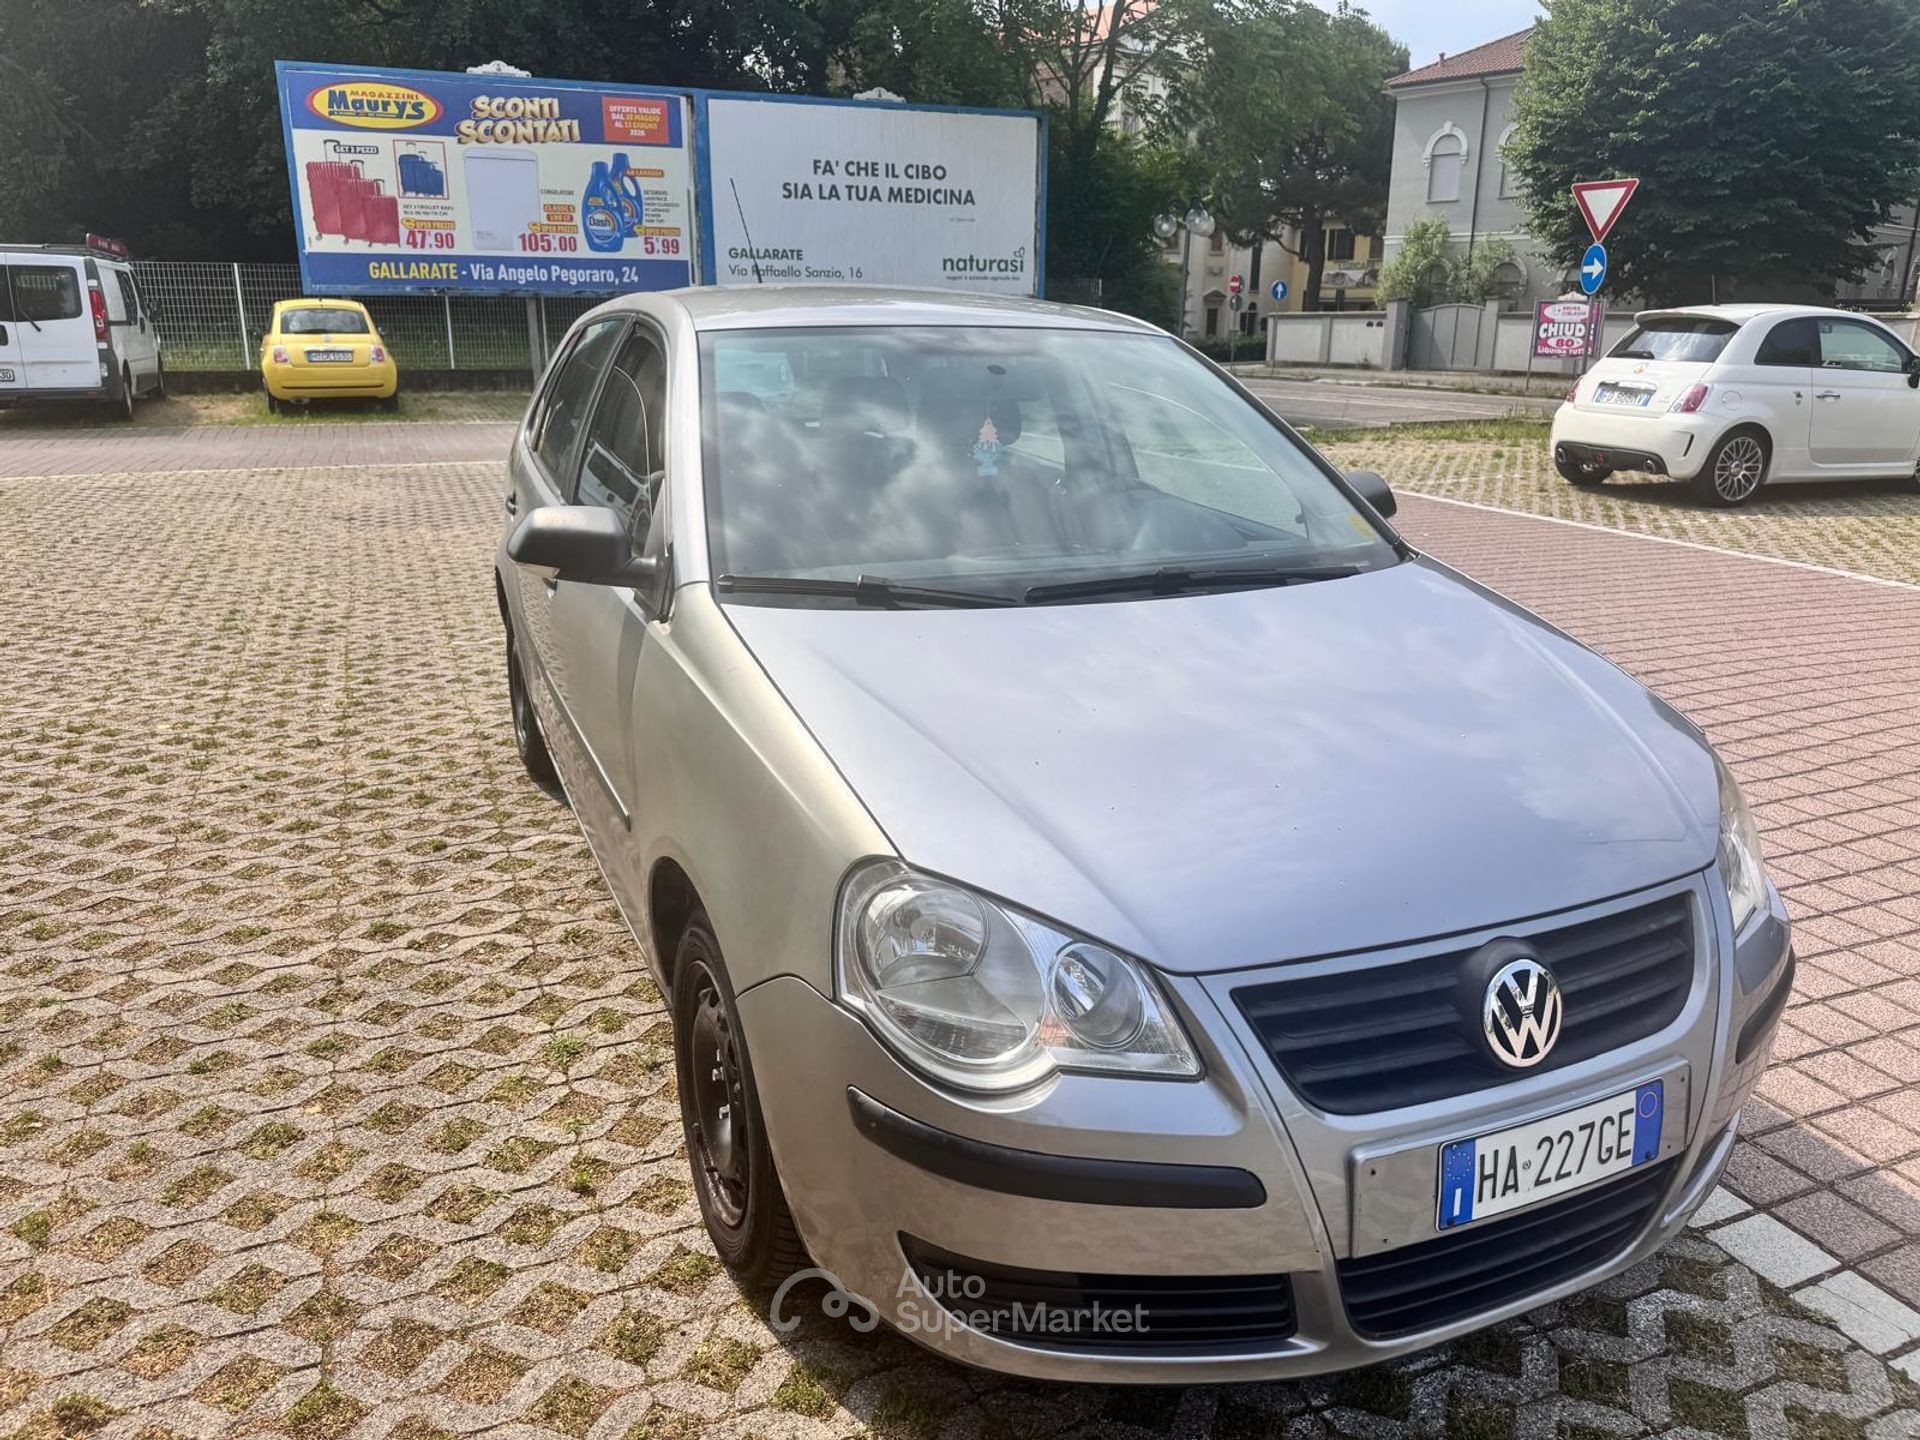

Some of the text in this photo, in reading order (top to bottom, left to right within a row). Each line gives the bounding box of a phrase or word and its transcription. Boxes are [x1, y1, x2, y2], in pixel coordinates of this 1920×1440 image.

[350, 90, 419, 100] MAGAZZINI
[470, 95, 560, 119] SCONTI
[609, 105, 662, 114] OFFERTE VALIDE
[455, 119, 581, 144] SCONTATI
[813, 159, 947, 181] FA' CHE IL CIBO
[782, 182, 976, 206] SIA LA TUA MEDICINA
[589, 216, 610, 227] Dash
[728, 247, 804, 260] GALLARATE
[369, 261, 458, 280] GALLARATE
[470, 264, 496, 281] Via
[498, 265, 548, 285] Angelo
[550, 265, 619, 286] Pegoraro,
[622, 267, 639, 283] 24
[728, 264, 748, 276] Via
[804, 266, 845, 280] Sanzio,
[849, 267, 863, 279] 16
[1478, 1145, 1520, 1204] HA
[1534, 1108, 1635, 1187] 227GE
